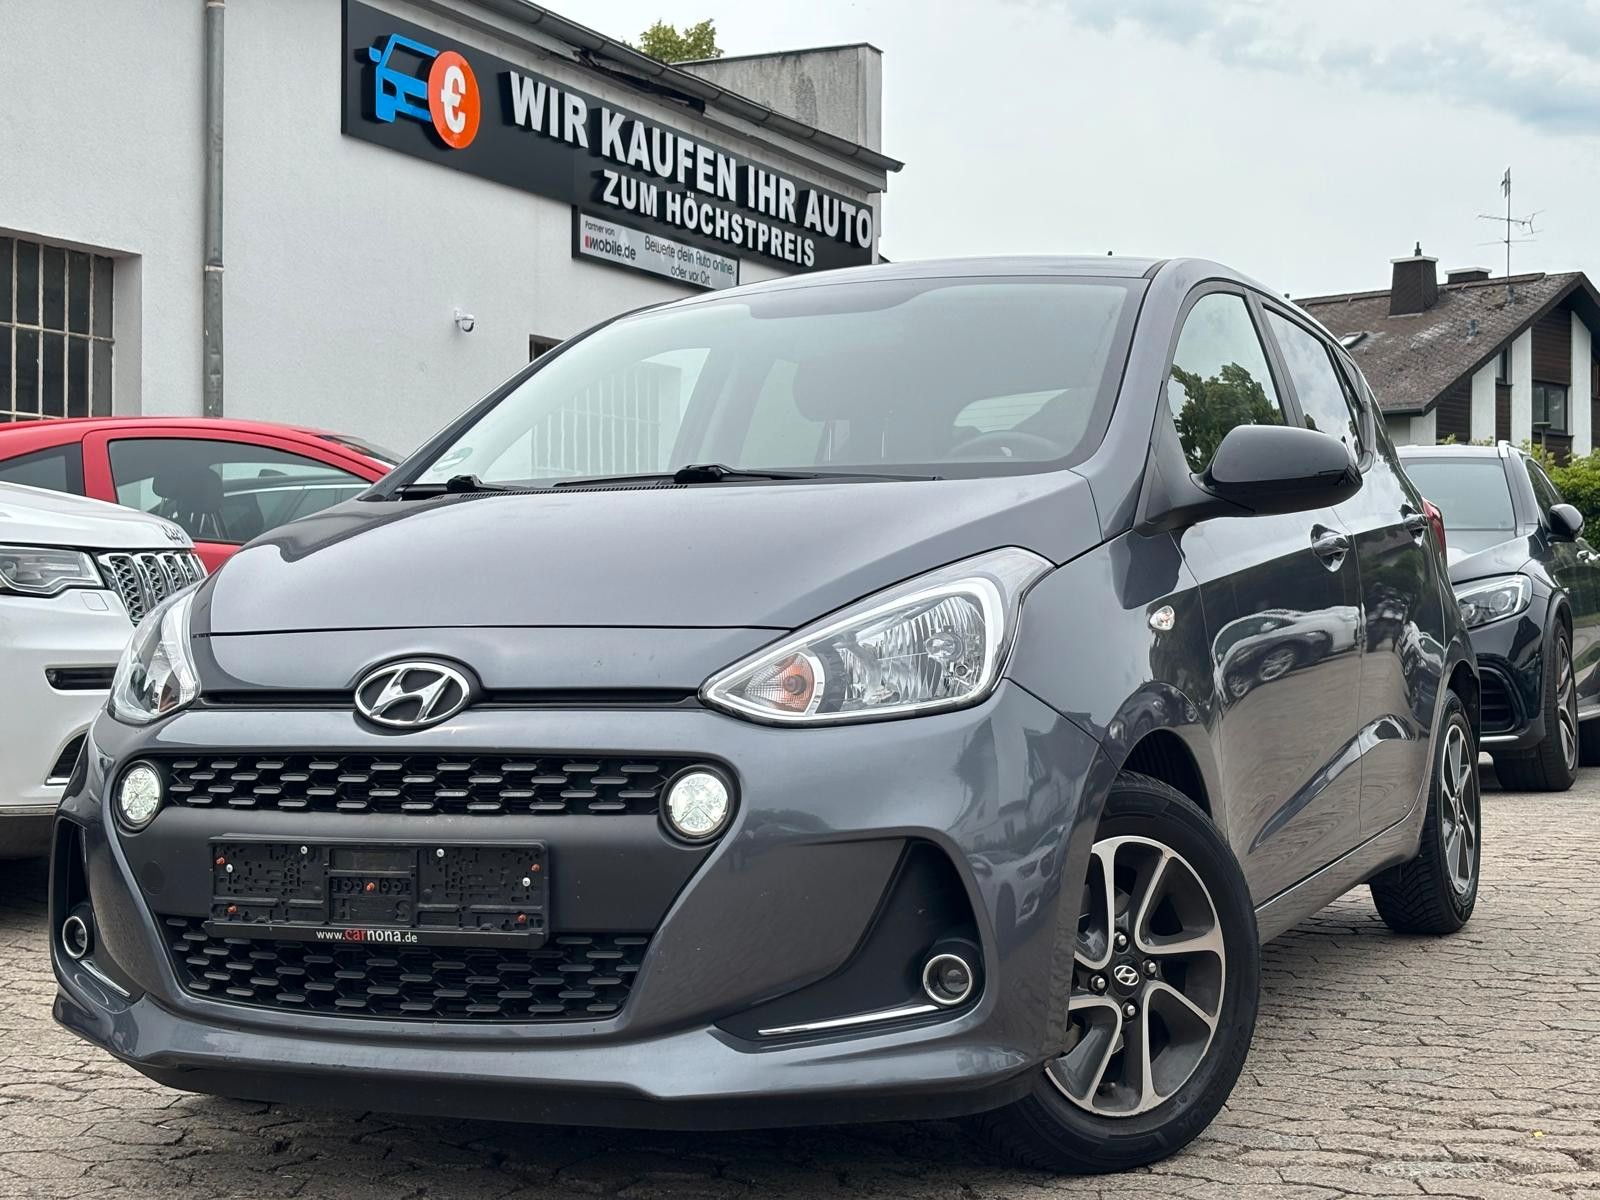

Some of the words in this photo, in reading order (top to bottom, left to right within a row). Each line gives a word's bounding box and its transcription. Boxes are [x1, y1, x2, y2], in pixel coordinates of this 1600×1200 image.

[509, 70, 589, 149] WIR
[601, 106, 737, 202] KAUFEN
[748, 164, 797, 224] IHR
[803, 188, 873, 249] AUTO
[584, 220, 605, 234] Partner
[604, 226, 616, 237] von
[602, 168, 658, 218] ZUM
[665, 190, 815, 267] HÖCHSTPREIS
[644, 235, 676, 258] Bewerte
[676, 246, 695, 265] dein
[695, 251, 712, 269] Auto
[670, 264, 688, 280] oder
[688, 269, 700, 282] vor
[315, 928, 418, 943] www.carnona.de
